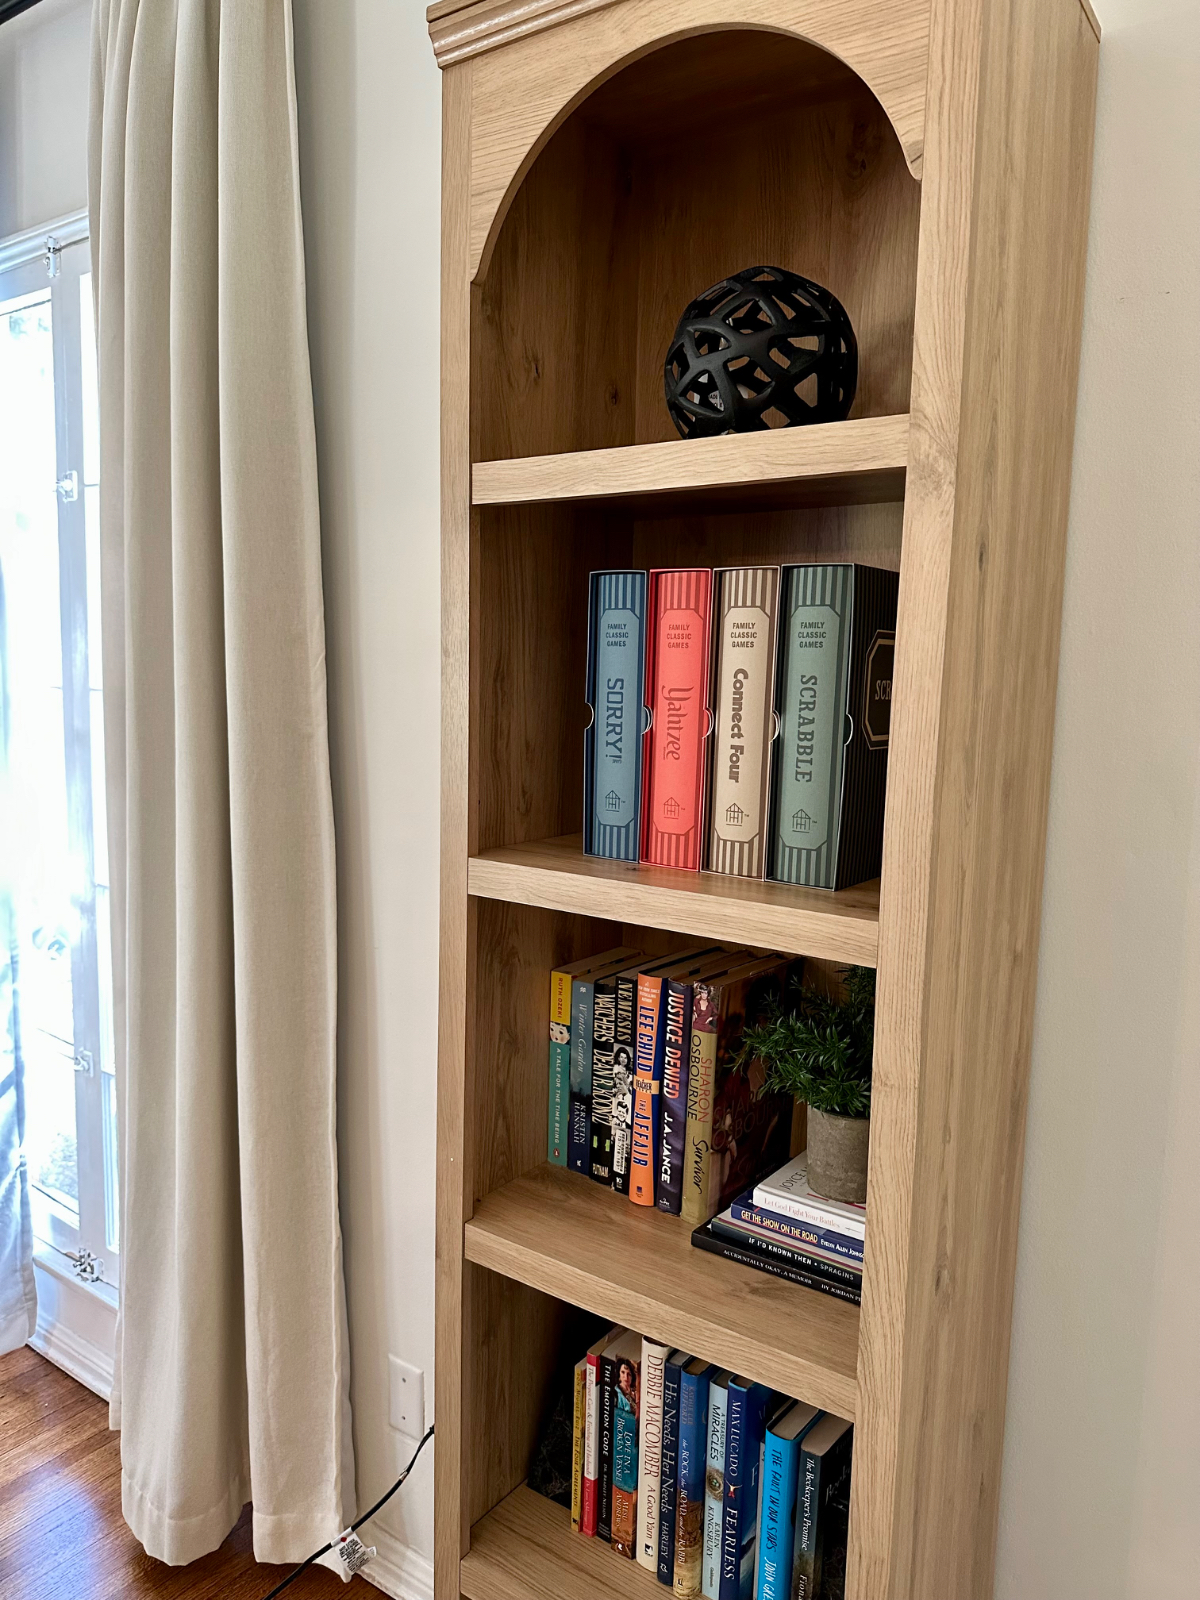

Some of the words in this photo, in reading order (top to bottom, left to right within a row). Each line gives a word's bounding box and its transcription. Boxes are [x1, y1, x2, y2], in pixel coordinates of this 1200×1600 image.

[730, 631, 758, 639] CLASSIC
[732, 622, 756, 630] FAMILY
[798, 631, 827, 639] CLASSIC
[800, 621, 825, 629] FAMILY
[605, 678, 624, 758] SORRY!
[730, 668, 749, 739] Connect
[661, 685, 694, 761] Yahtzee
[795, 674, 818, 782] SCRABBLE
[728, 744, 744, 783] Four
[578, 1003, 587, 1037] Winter
[593, 993, 616, 1043] WATCHERS
[617, 980, 633, 1042] NEMESIS
[638, 1005, 655, 1031] LEE
[665, 989, 685, 1045] JUSTICE
[577, 1038, 587, 1073] Garden
[592, 1048, 615, 1078] DEAN
[636, 1032, 654, 1073] CHILD
[663, 1045, 683, 1099] DENIED
[687, 1034, 702, 1121] OSBOURNE
[591, 1086, 613, 1126] KOONTZ
[638, 1099, 647, 1112] THE
[697, 1056, 713, 1124] SHARON
[632, 1111, 651, 1168] AFFAIR
[663, 1111, 673, 1137] J.A.
[592, 1162, 609, 1178] PUTNAM
[661, 1139, 672, 1184] JANCE
[692, 1135, 709, 1195] Survivor
[780, 1172, 808, 1193] JOYCE
[741, 1210, 751, 1220] GET
[751, 1213, 762, 1224] THE
[762, 1216, 780, 1230] SHOW
[780, 1223, 790, 1234] ON
[790, 1226, 801, 1237] THE
[801, 1230, 819, 1243] ROAD
[764, 1197, 774, 1207] Let
[774, 1200, 788, 1212] God
[788, 1203, 804, 1217] Fight
[804, 1210, 819, 1221] Your
[819, 1215, 841, 1228] Battles
[723, 1249, 764, 1268] ACCIDENTALLY
[788, 1271, 812, 1285] MEMOIR
[821, 1283, 830, 1291] BY
[830, 1286, 854, 1300] JORDAN
[757, 1240, 767, 1248] I'D
[768, 1243, 792, 1259] KNOWN
[793, 1253, 812, 1266] THEN
[820, 1263, 854, 1281] SPRAGINS
[604, 1365, 612, 1383] THE
[646, 1354, 664, 1400] DEBBIE
[603, 1385, 611, 1428] EMOTION
[664, 1380, 678, 1404] His
[681, 1383, 689, 1425] GIFFORD
[663, 1406, 677, 1446] Needs,
[731, 1399, 742, 1427] MAX
[602, 1430, 610, 1457] CODE
[616, 1417, 626, 1450] BROKEN
[623, 1431, 633, 1454] LOVE
[644, 1400, 662, 1478] MACOMBER
[710, 1403, 721, 1461] MIRACLES
[615, 1454, 624, 1482] VESSEL
[623, 1455, 631, 1464] IN
[662, 1448, 675, 1475] Her
[719, 1451, 725, 1459] OF
[729, 1427, 740, 1477] LUCADO
[771, 1449, 783, 1468] THE
[806, 1457, 815, 1471] The
[623, 1465, 631, 1474] A
[769, 1470, 783, 1496] FAULT
[647, 1484, 656, 1493] A
[660, 1476, 674, 1514] Needs
[769, 1494, 780, 1508] IN
[801, 1471, 815, 1517] Beekeeper's
[615, 1491, 623, 1528] ANDREWS
[646, 1494, 656, 1519] Good
[767, 1506, 779, 1524] OUR
[645, 1519, 655, 1540] Yarn
[660, 1521, 669, 1559] HARLEY
[706, 1505, 715, 1559] KINGSBURY
[723, 1506, 738, 1580] FEARLESS
[765, 1524, 778, 1553] STARS
[801, 1517, 812, 1551] Promise
[677, 1538, 687, 1565] RABBI
[764, 1556, 777, 1583] JOHN
